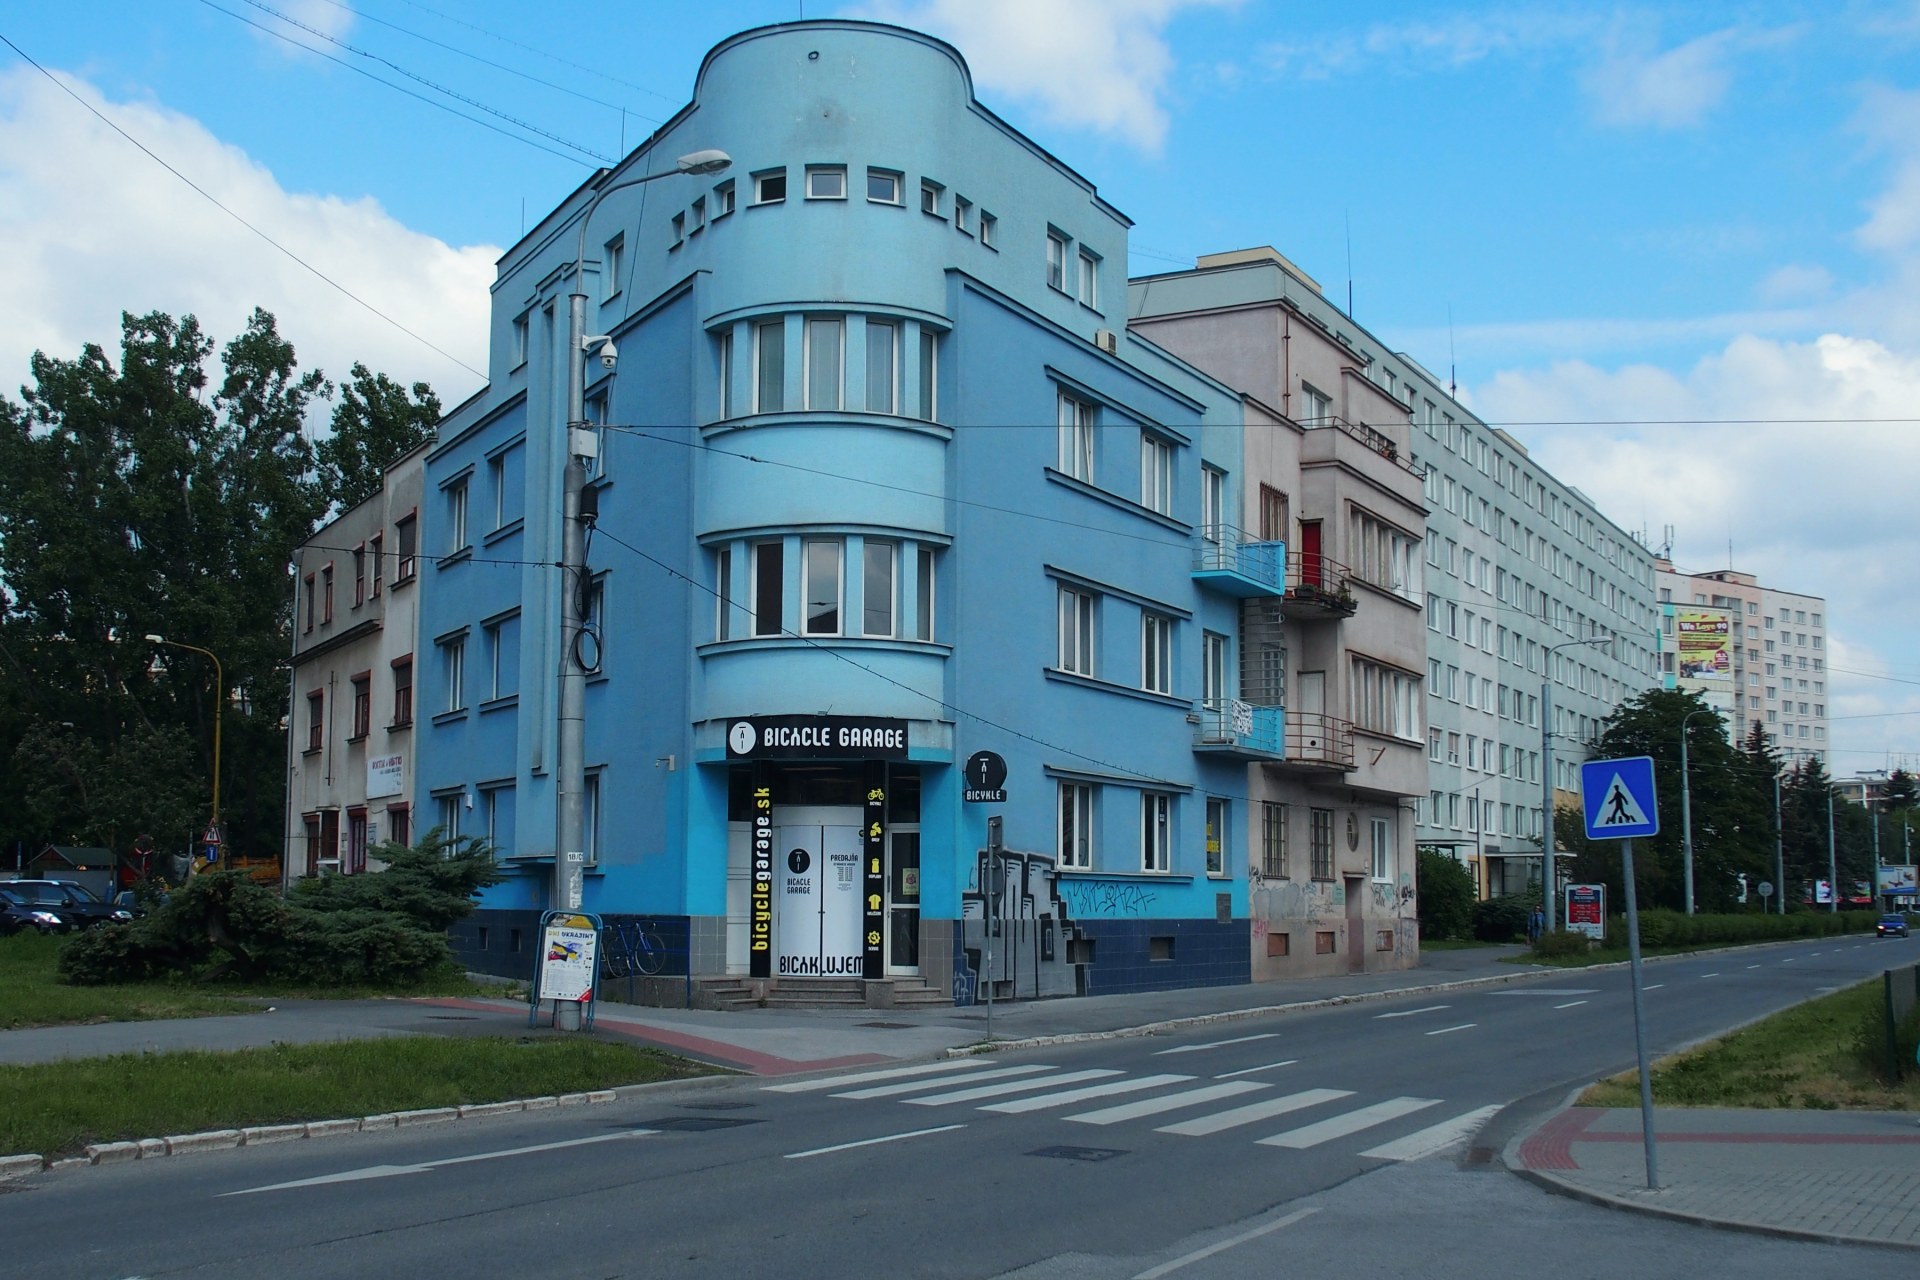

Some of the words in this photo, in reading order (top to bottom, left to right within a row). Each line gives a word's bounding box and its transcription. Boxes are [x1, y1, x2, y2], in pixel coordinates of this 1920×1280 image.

[1681, 622, 1695, 630] We
[1696, 623, 1716, 631] Love
[764, 727, 831, 747] BICYCLE
[839, 728, 904, 748] GARAGE
[966, 790, 1001, 801] BICYKLE
[752, 787, 772, 951] bicyclegarage.sk
[787, 878, 811, 886] BICYCLE
[787, 887, 811, 895] GARAGE
